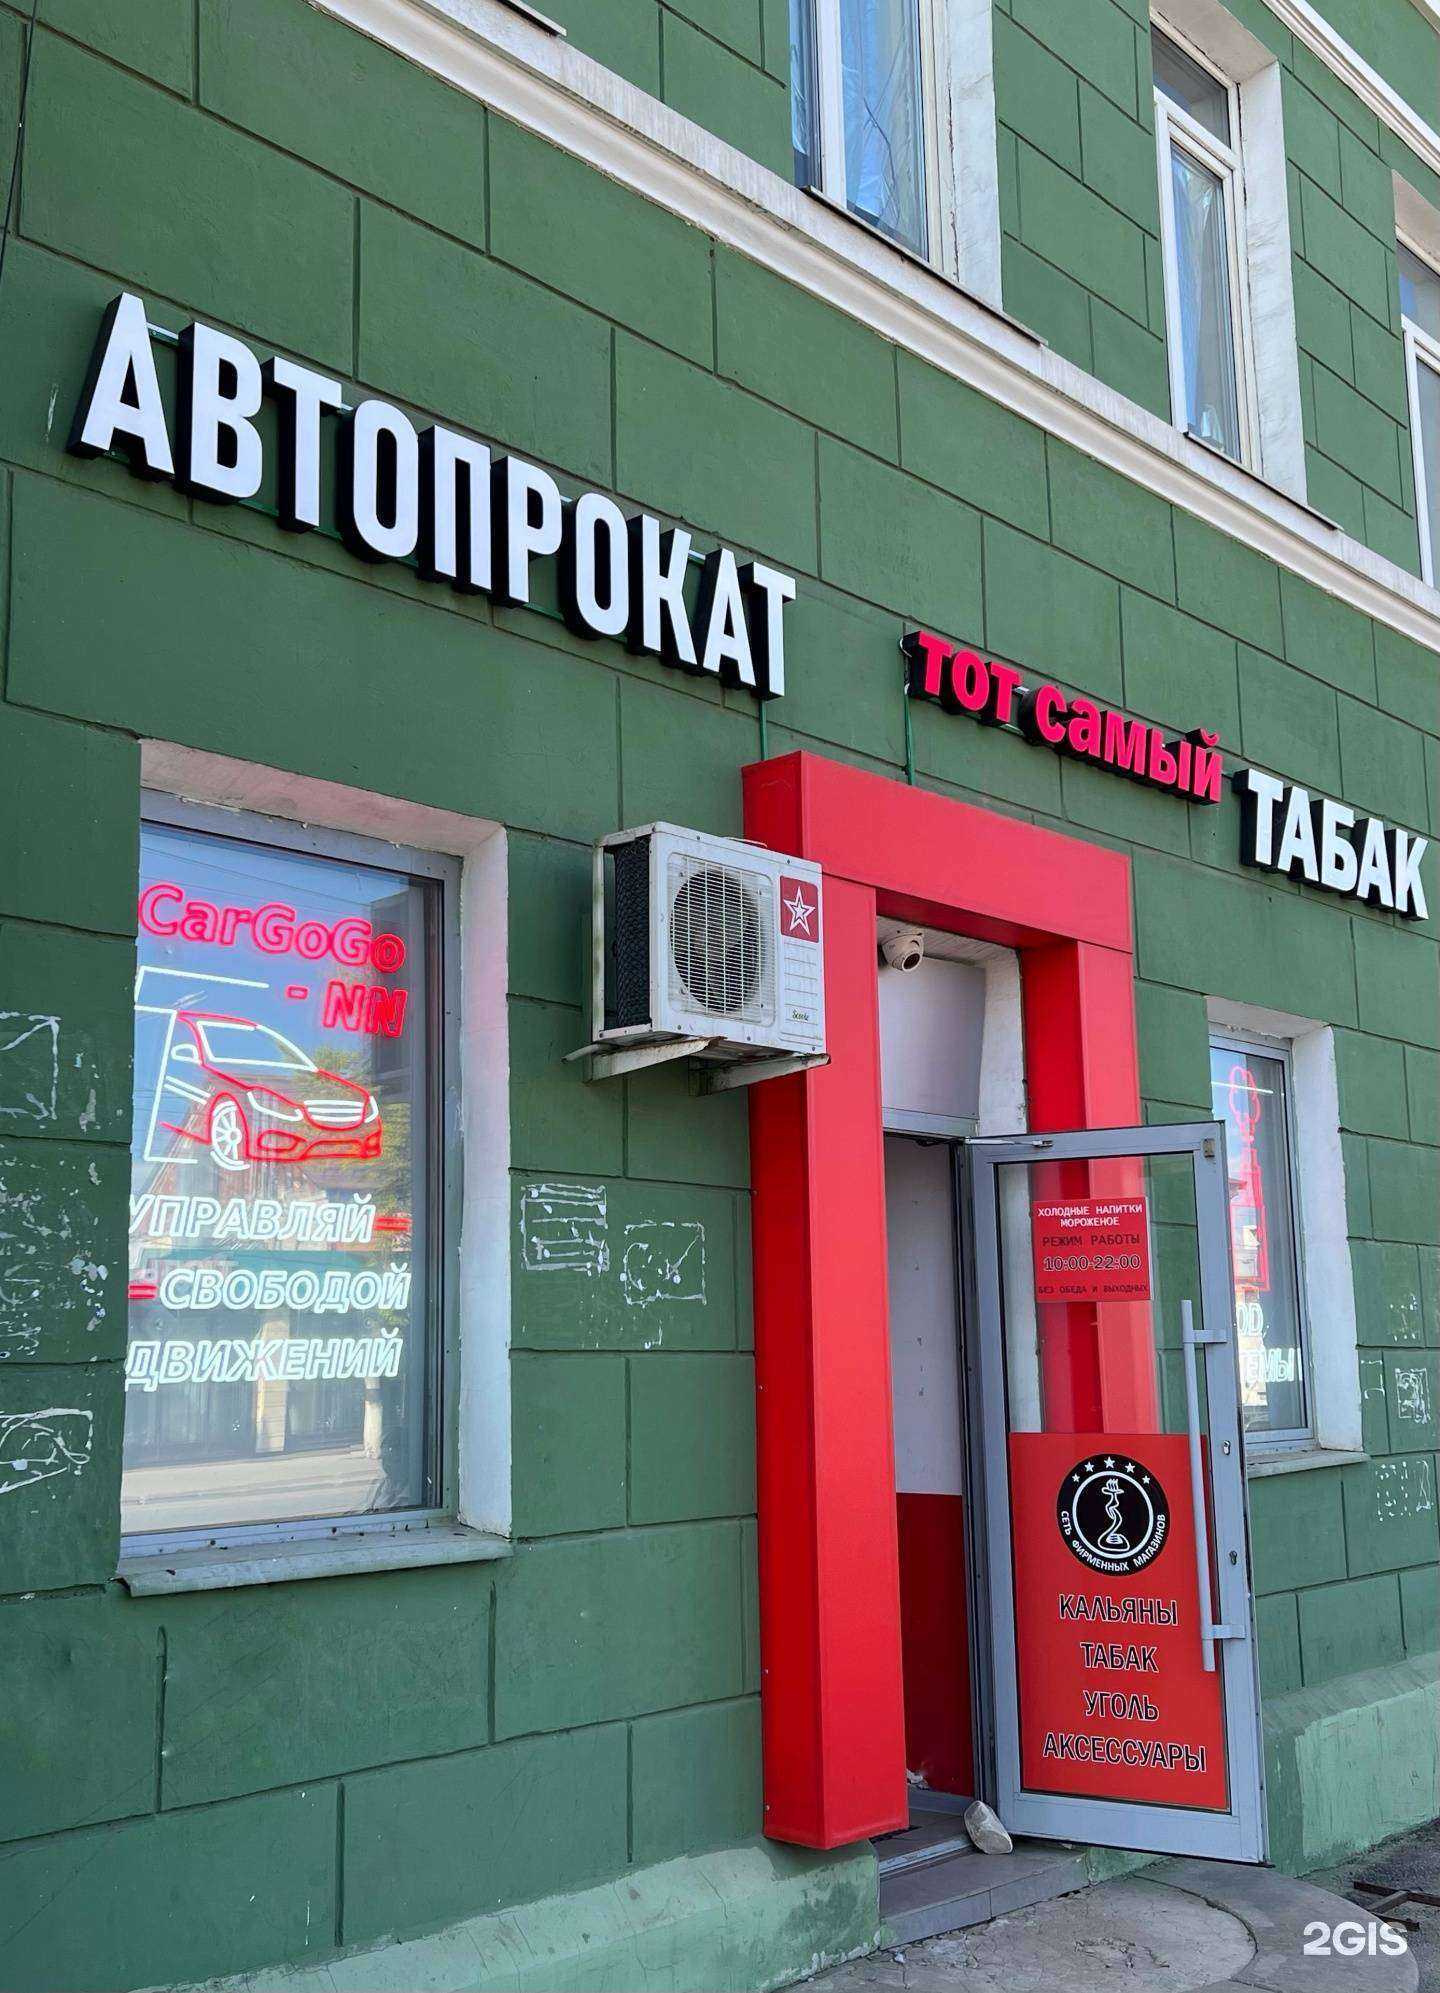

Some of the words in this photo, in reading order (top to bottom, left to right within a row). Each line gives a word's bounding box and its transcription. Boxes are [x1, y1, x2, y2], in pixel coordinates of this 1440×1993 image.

[74, 291, 797, 699] АВТОПРОКАТ
[1246, 768, 1429, 920] ТАБАК
[138, 884, 407, 975] CarGoGo
[128, 1193, 376, 1244] УПРАВЛЯЙ
[1038, 1207, 1090, 1217] ХОЛОДНЫЕ
[1096, 1204, 1143, 1215] НАПИТКИ
[1060, 1217, 1120, 1228] МОРОЖЕНОЕ
[1042, 1235, 1083, 1247] РЕЖИМ
[1090, 1233, 1140, 1246] РАБОТЫ
[1043, 1255, 1141, 1271] 10:00-22:00
[159, 1262, 412, 1314] СВОБОДОЙ
[1038, 1285, 1055, 1295] БЕЗ
[1059, 1285, 1087, 1294] ОБЕДА
[124, 1327, 404, 1392] ДВИЖЕНИЙ
[1061, 1510, 1072, 1536] СЕТЬ
[1072, 1540, 1130, 1572] ФИРМЕННЫХ
[1133, 1514, 1166, 1567] МАГАЗИНОВ
[1058, 1593, 1179, 1626] КАЛЬЯНЫ
[1080, 1642, 1159, 1673] ТАБАК
[1083, 1690, 1160, 1722] УГОЛЬ
[1042, 1732, 1207, 1772] АКСЕССУАРЫ
